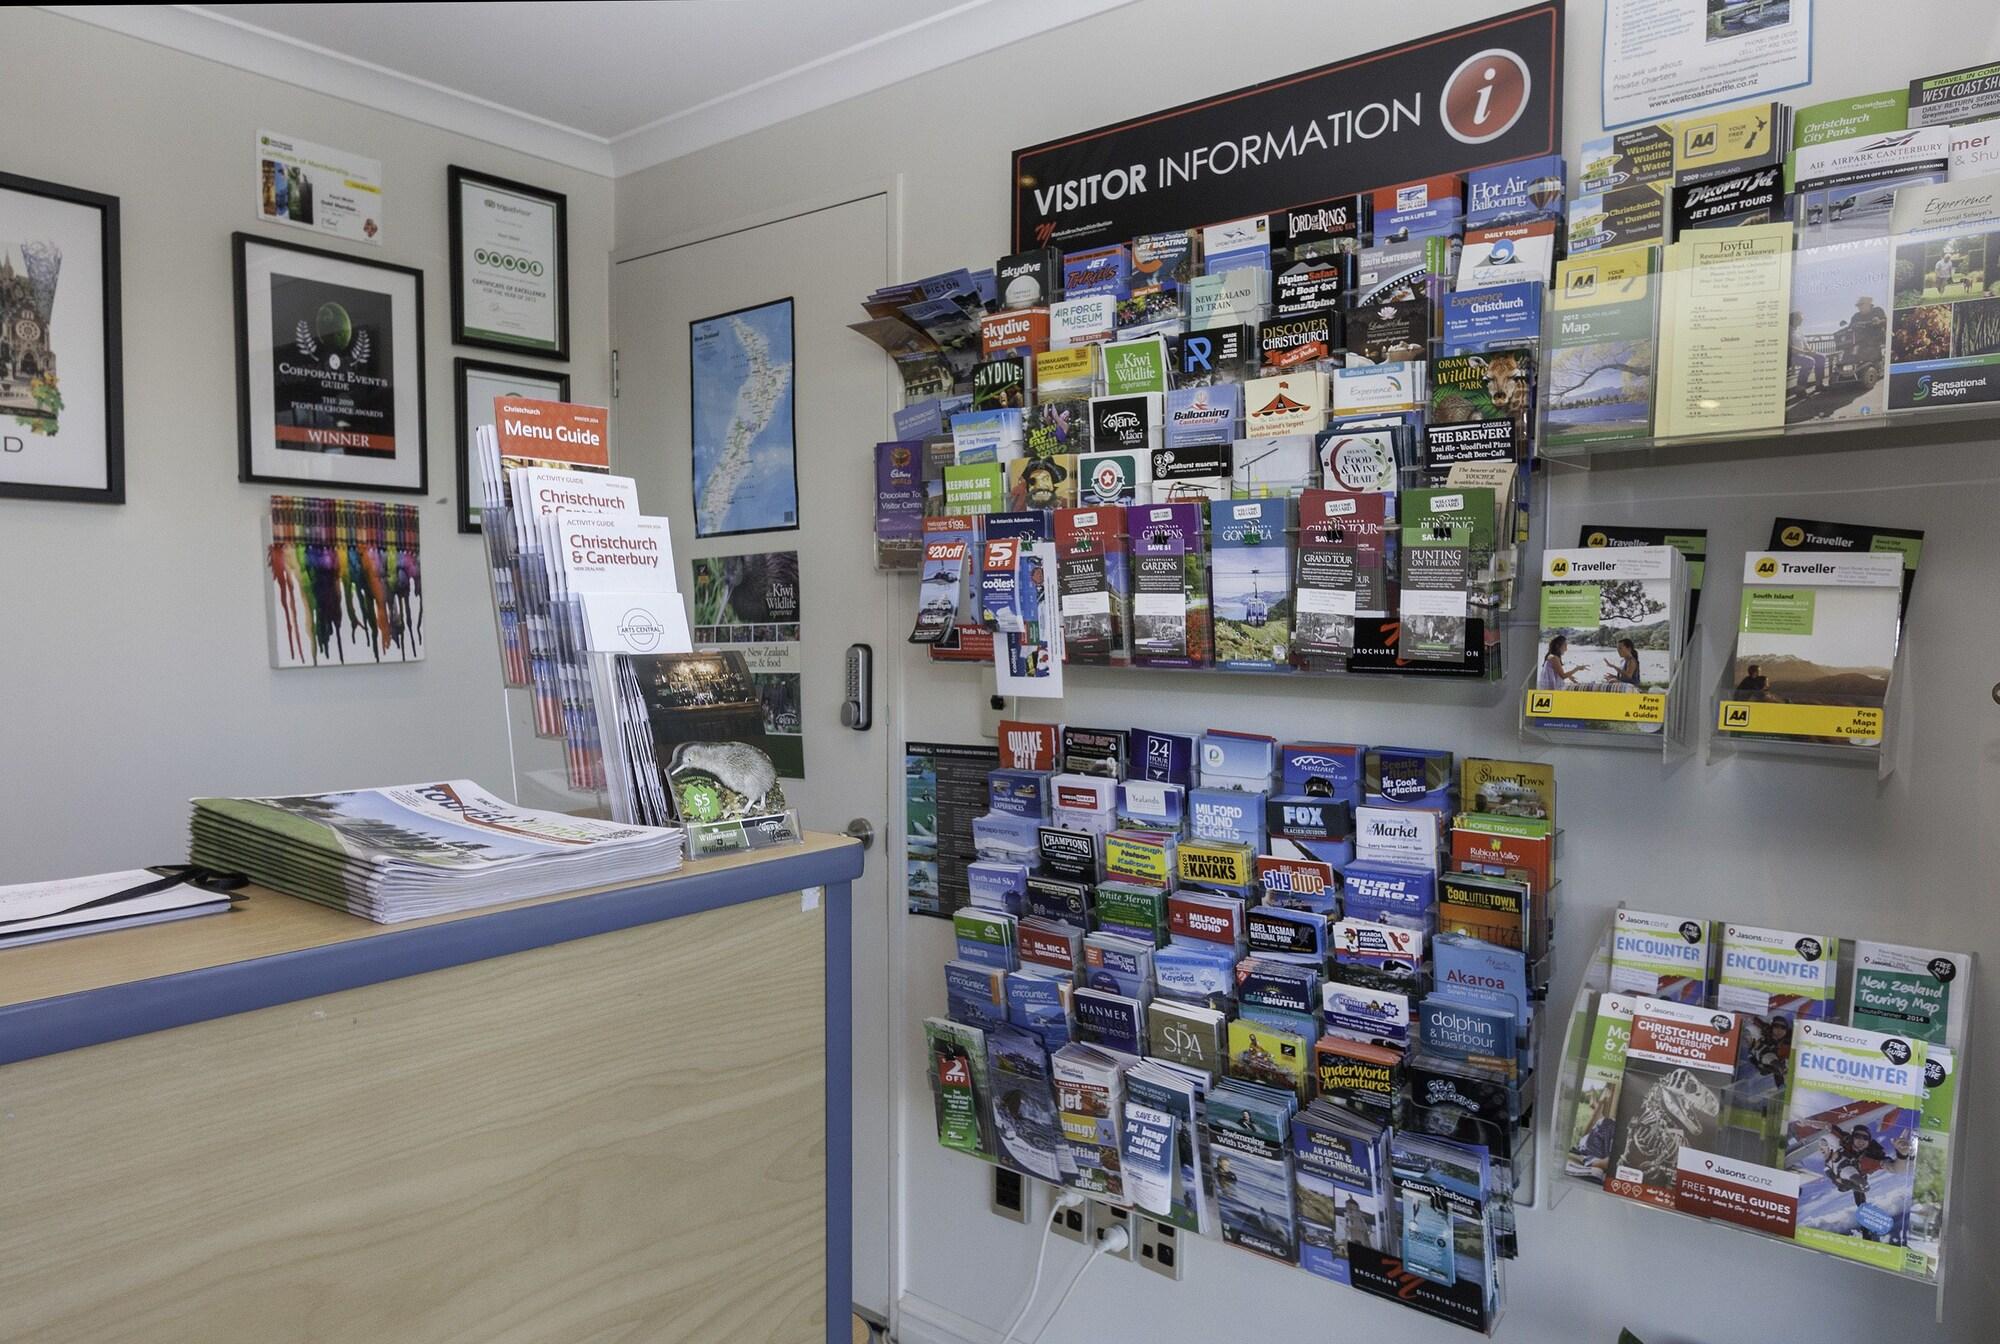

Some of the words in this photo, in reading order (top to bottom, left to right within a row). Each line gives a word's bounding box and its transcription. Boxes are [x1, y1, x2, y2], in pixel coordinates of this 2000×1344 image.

[1648, 78, 1759, 108] www.westcoastshuttle.co.nz
[1922, 108, 1960, 120] Greymouth
[1804, 114, 1870, 134] Christchurch
[1803, 132, 1825, 144] City
[1826, 126, 1857, 139] Parks
[1034, 164, 1147, 216] VISITOR
[1158, 92, 1422, 189] INFORMATION
[1831, 153, 1874, 167] AIRPARK
[1876, 143, 1943, 159] CANTERBURY
[1471, 183, 1503, 200] Hot
[1506, 178, 1528, 193] Air
[1471, 194, 1528, 213] Ballooning
[1609, 199, 1661, 217] Christchurch
[1690, 208, 1709, 220] JET
[1710, 199, 1737, 216] BOAT
[1739, 194, 1773, 211] TOURS
[1484, 229, 1505, 239] DAILY
[1506, 227, 1528, 237] TOURS
[1719, 239, 1754, 255] Joyful
[1001, 261, 1041, 279] skydive
[472, 278, 505, 292] CERTIFICATE
[1194, 295, 1212, 306] NEW
[1213, 288, 1251, 302] ZEALAND
[1300, 291, 1315, 301] and
[1054, 306, 1071, 321] AIR
[1071, 302, 1103, 317] FORCE
[1194, 304, 1206, 314] BY
[1206, 300, 1232, 311] TRAIN
[1471, 298, 1524, 314] Christchurch
[983, 319, 1031, 339] skydive
[1061, 313, 1103, 327] MUSEUM
[1262, 317, 1329, 339] DISCOVER
[1562, 321, 1591, 336] Map
[1262, 329, 1330, 351] CHRISTCHURCH
[1438, 358, 1468, 370] ORANA
[278, 363, 346, 383] CORPORATE
[347, 371, 389, 388] EVENTS
[1115, 365, 1156, 382] Wildlife
[1437, 365, 1488, 386] Wildlife
[321, 380, 350, 393] GUIDE
[1459, 379, 1483, 391] PARK
[1931, 377, 1987, 390] Sensational
[1931, 386, 1968, 399] Selwyn
[354, 409, 384, 420] AWARDS
[1173, 408, 1230, 422] Ballooning
[307, 429, 370, 450] WINNER
[504, 419, 553, 444] Menu
[555, 426, 601, 448] Guide
[1430, 431, 1454, 444] THE
[1455, 427, 1513, 442] BREWERY
[539, 488, 626, 512] Christchurch
[569, 534, 658, 553] Christchurch
[928, 546, 947, 558] $20
[946, 544, 963, 558] off
[571, 551, 584, 567] &
[585, 551, 660, 570] Canterbury
[1303, 554, 1332, 565] GRAND
[1332, 554, 1353, 565] TOUR
[1411, 549, 1462, 562] PUNTING
[1411, 559, 1424, 567] ON
[1424, 558, 1438, 567] THE
[1438, 558, 1461, 567] AVON
[1071, 563, 1094, 575] TRAM
[1141, 561, 1178, 572] GARDENS
[1552, 562, 1569, 574] AA
[1572, 561, 1617, 574] Traveller
[1758, 563, 1776, 575] AA
[1781, 562, 1837, 576] Traveller
[772, 583, 794, 598] Kiwi
[766, 597, 797, 611] Wildlife
[1535, 698, 1552, 709] AA
[1638, 703, 1660, 713] Maps
[1642, 696, 1660, 704] Free
[1728, 710, 1748, 722] AA
[1852, 718, 1877, 729] Maps
[1857, 710, 1877, 719] Free
[1007, 730, 1043, 753] QUAKE
[1149, 738, 1170, 757] 24
[1014, 750, 1037, 770] CITY
[1194, 803, 1243, 820] MILFORD
[1282, 805, 1325, 829] FOX
[1195, 815, 1234, 830] SOUND
[1371, 823, 1418, 839] Market
[1195, 826, 1241, 842] FLIGHTS
[1043, 833, 1089, 854] CHAMPIONS
[1188, 854, 1235, 866] MILFORD
[1470, 847, 1499, 859] Rubicon
[1499, 849, 1521, 864] Valley
[1189, 864, 1238, 882] KAYAKS
[1264, 869, 1326, 896] skydive
[1098, 890, 1122, 906] White
[1124, 892, 1153, 907] Heron
[1188, 911, 1230, 928] MILFORD
[1189, 919, 1222, 935] SOUND
[1249, 921, 1266, 934] ABEL
[1267, 924, 1296, 939] TASMAN
[1249, 931, 1277, 944] NATIONAL
[1277, 934, 1293, 946] PARK
[1359, 936, 1385, 945] FRENCH
[1616, 936, 1701, 963] ENCOUNTER
[1726, 953, 1820, 979] ENCOUNTER
[1446, 968, 1506, 991] Akaroa
[1860, 975, 1888, 990] New
[1890, 979, 1945, 999] Zealand
[1079, 1002, 1129, 1023] HANMER
[1859, 990, 1909, 1012] Touring
[1911, 998, 1941, 1017] Map
[1431, 1010, 1493, 1038] dolphin
[1430, 1030, 1438, 1040] &
[1440, 1029, 1496, 1051] harbour
[1637, 1020, 1730, 1048] CHRISTCHURCH
[1650, 1032, 1657, 1041] &
[1656, 1034, 1714, 1053] CANTERBURY
[1812, 1028, 1869, 1047] Jasons.co.nz
[1163, 1028, 1204, 1062] SPA
[1654, 1040, 1690, 1057] What's
[1691, 1047, 1707, 1061] On
[1889, 1041, 1907, 1053] FREE
[1319, 1064, 1391, 1082] UnderWorld
[1799, 1052, 1910, 1087] ENCOUNTER
[1323, 1076, 1392, 1094] Adventures
[1058, 1088, 1083, 1112] jet
[1714, 1165, 1774, 1187] Jasons.co.nz
[1681, 1179, 1707, 1194] FREE
[1707, 1185, 1748, 1205] TRAVEL
[1749, 1196, 1792, 1217] GUIDES
